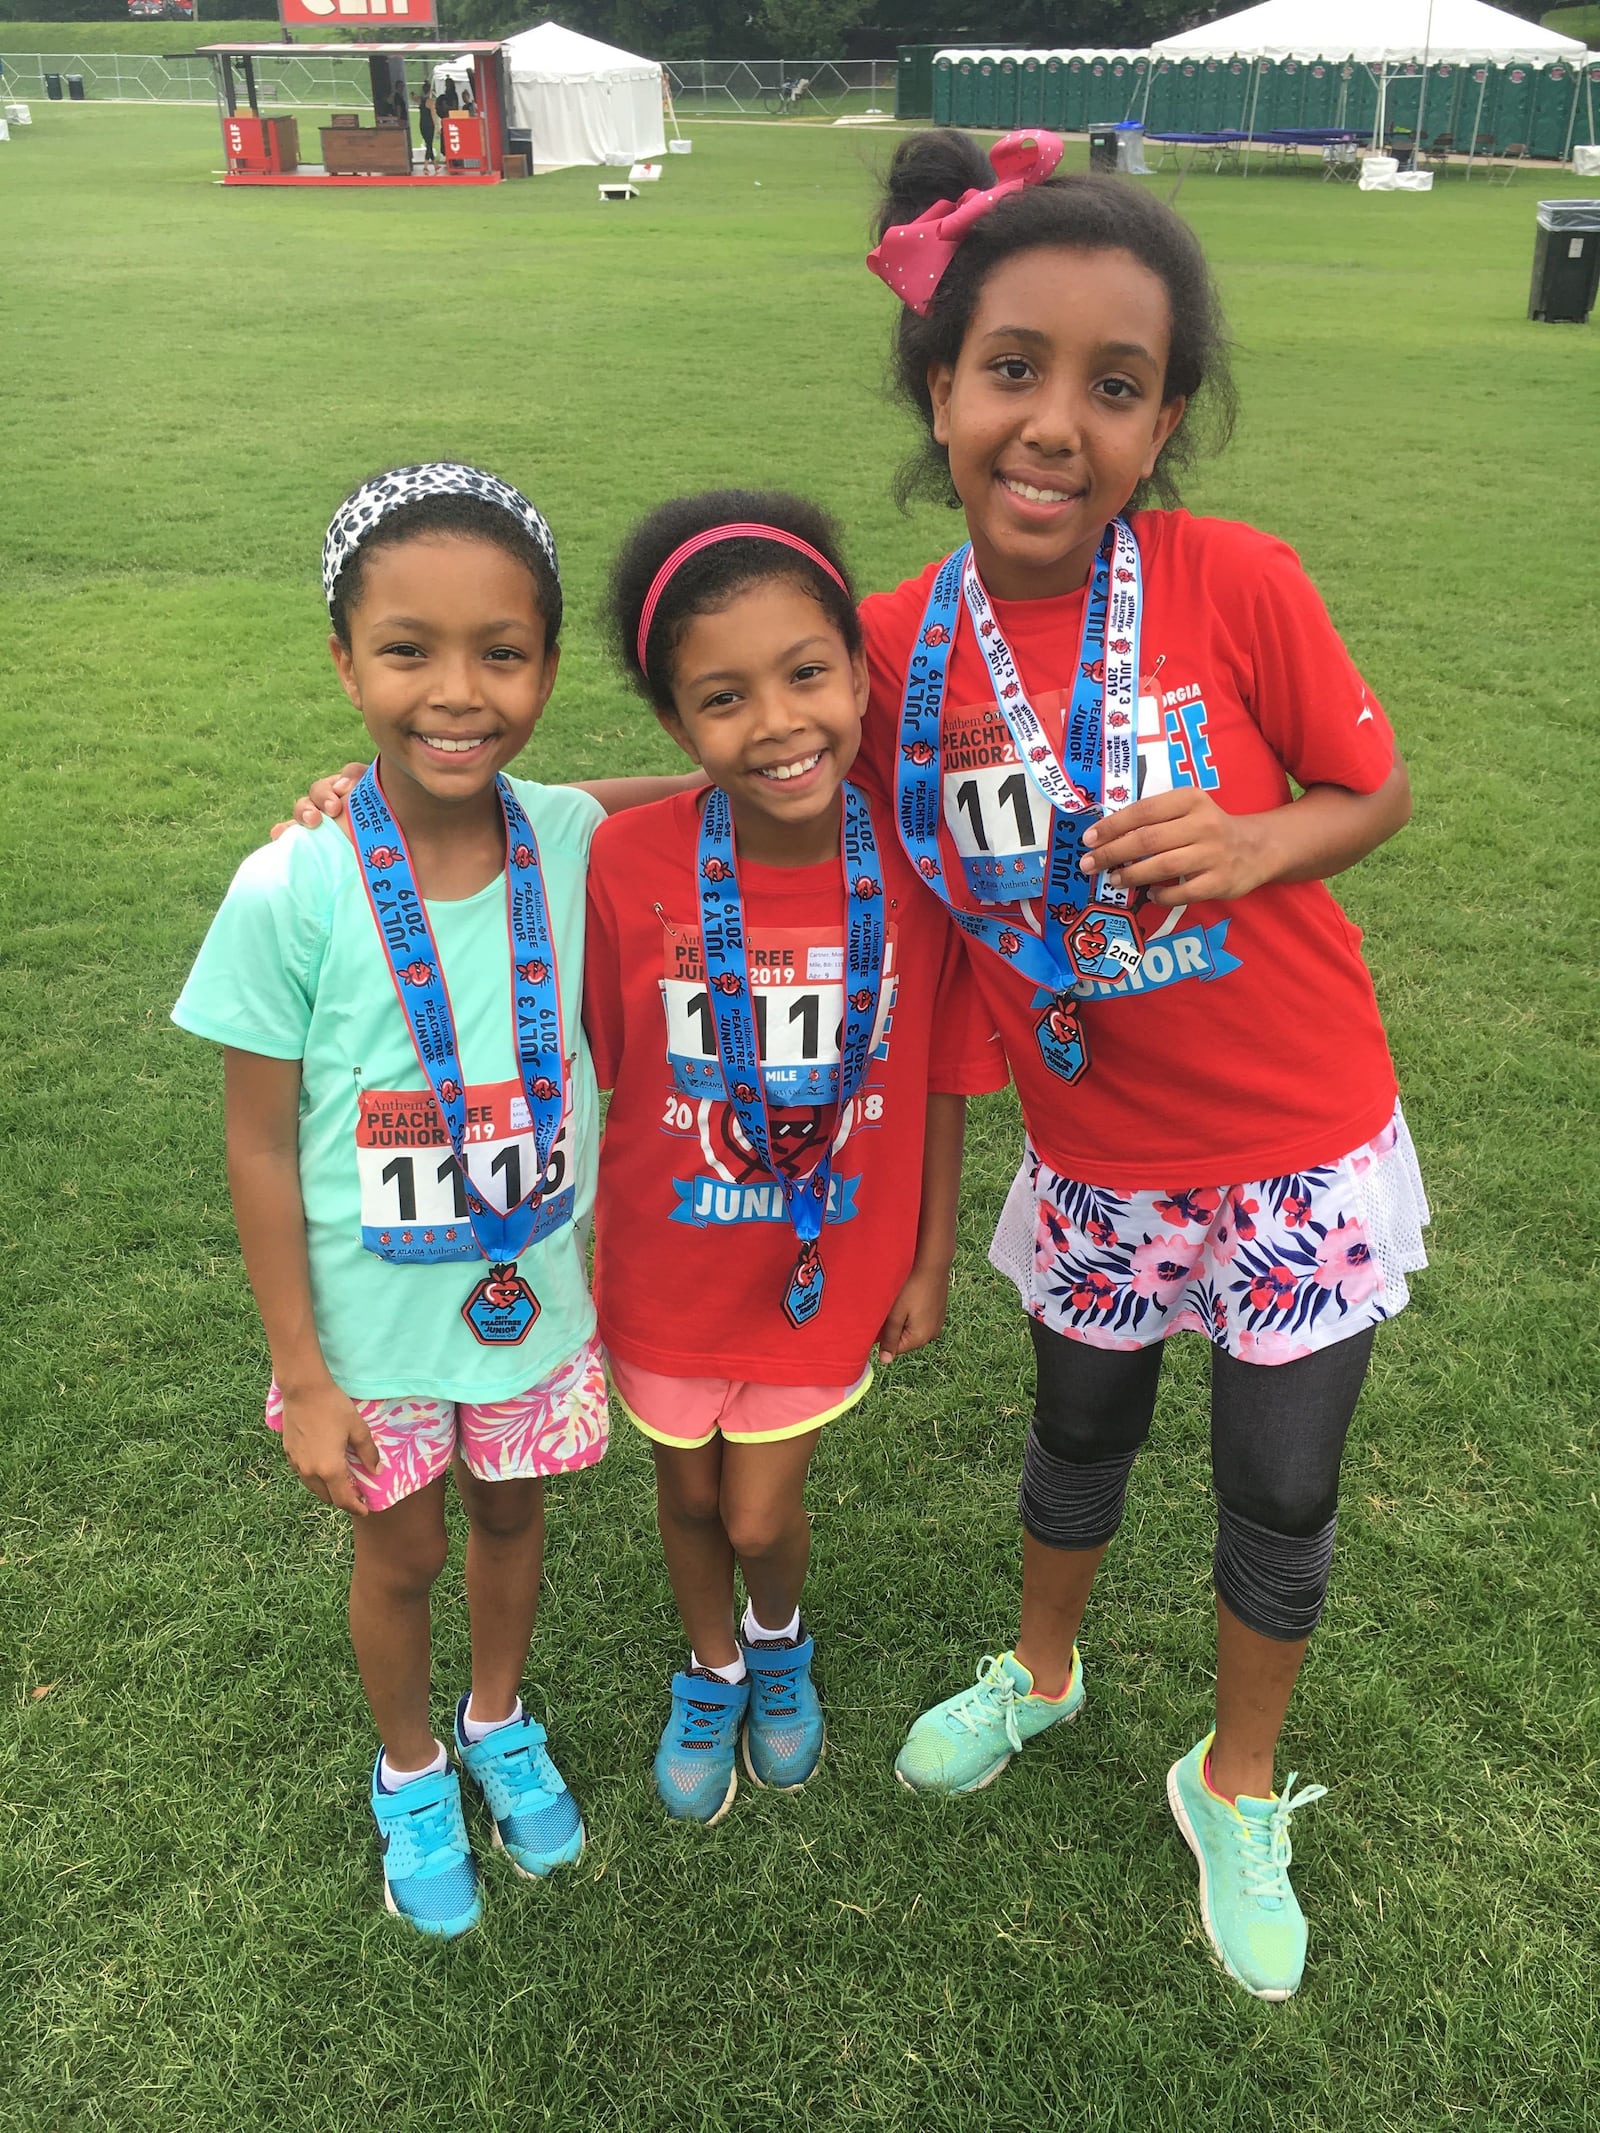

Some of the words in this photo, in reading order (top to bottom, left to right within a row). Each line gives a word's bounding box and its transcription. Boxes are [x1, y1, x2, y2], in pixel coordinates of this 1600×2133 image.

[230, 124, 242, 152] CLIF
[448, 124, 460, 152] CLIF
[1117, 525, 1126, 553] 2019
[1125, 556, 1135, 565] 3
[941, 560, 956, 610] ACHTREE
[1085, 589, 1108, 649] JULY
[1117, 590, 1128, 633] PEACHTREE
[1124, 595, 1135, 630] JUNIOR
[912, 655, 928, 668] 3
[988, 649, 1003, 676] 2019
[992, 638, 1011, 669] JULY
[1005, 668, 1015, 679] 3
[1119, 659, 1132, 693] JULY
[924, 669, 944, 718] 2019
[1107, 667, 1118, 697] 2019
[1119, 697, 1131, 705] 3
[904, 674, 926, 732] JULY
[1012, 703, 1034, 743] PEACHTREE
[1020, 703, 1040, 735] JUNIOR
[1070, 704, 1089, 763] JUNIOR
[1082, 698, 1102, 773] PEACHTREE
[1113, 735, 1121, 778] PEACHTREE
[1121, 739, 1131, 774] JUNIOR
[846, 793, 856, 806] 3
[1037, 775, 1058, 797] 2019
[1045, 764, 1069, 794] JULY
[1063, 791, 1074, 799] 3
[358, 778, 384, 834] ACHTREE
[705, 792, 717, 838] UNIOR
[714, 791, 724, 844] ACHTREE
[900, 785, 915, 840] JUNIOR
[915, 780, 926, 845] PEACHTREE
[927, 787, 938, 822] Anthem
[845, 811, 862, 866] JULY
[859, 807, 876, 852] 2019
[1057, 820, 1076, 833] 3
[1051, 837, 1074, 894] JULY
[372, 879, 392, 893] 3
[703, 891, 721, 903] 3
[376, 900, 411, 953] JULY
[397, 889, 427, 937] 2019
[512, 887, 528, 942] JUNIOR
[523, 882, 539, 949] PEACHTREE
[533, 889, 545, 924] Anthem
[723, 903, 743, 950] 2019
[704, 911, 726, 963] JULY
[850, 920, 862, 972] JUNIOR
[860, 913, 872, 978] PEACHTREE
[872, 920, 882, 955] Anthem
[1109, 945, 1139, 966] 2nd
[517, 996, 536, 1008] 3
[414, 1010, 436, 1064] JUNIOR
[424, 999, 447, 1067] PEACHTREE
[437, 1004, 450, 1041] Anthem
[539, 1008, 559, 1054] 2019
[720, 1015, 736, 1065] JUNIOR
[731, 1008, 746, 1072] PEACHTREE
[743, 1015, 752, 1050] Anthem
[847, 1023, 860, 1036] 3
[518, 1018, 541, 1068] JULY
[853, 1033, 870, 1074] 2019
[765, 1070, 797, 1082] MILE
[843, 1042, 857, 1089] JULY
[367, 1106, 494, 1128] PEACHEE
[662, 1095, 693, 1130] 20
[739, 1110, 752, 1121] 3
[428, 1247, 458, 1256] Anthem
[484, 1326, 517, 1334] JUNIOR
